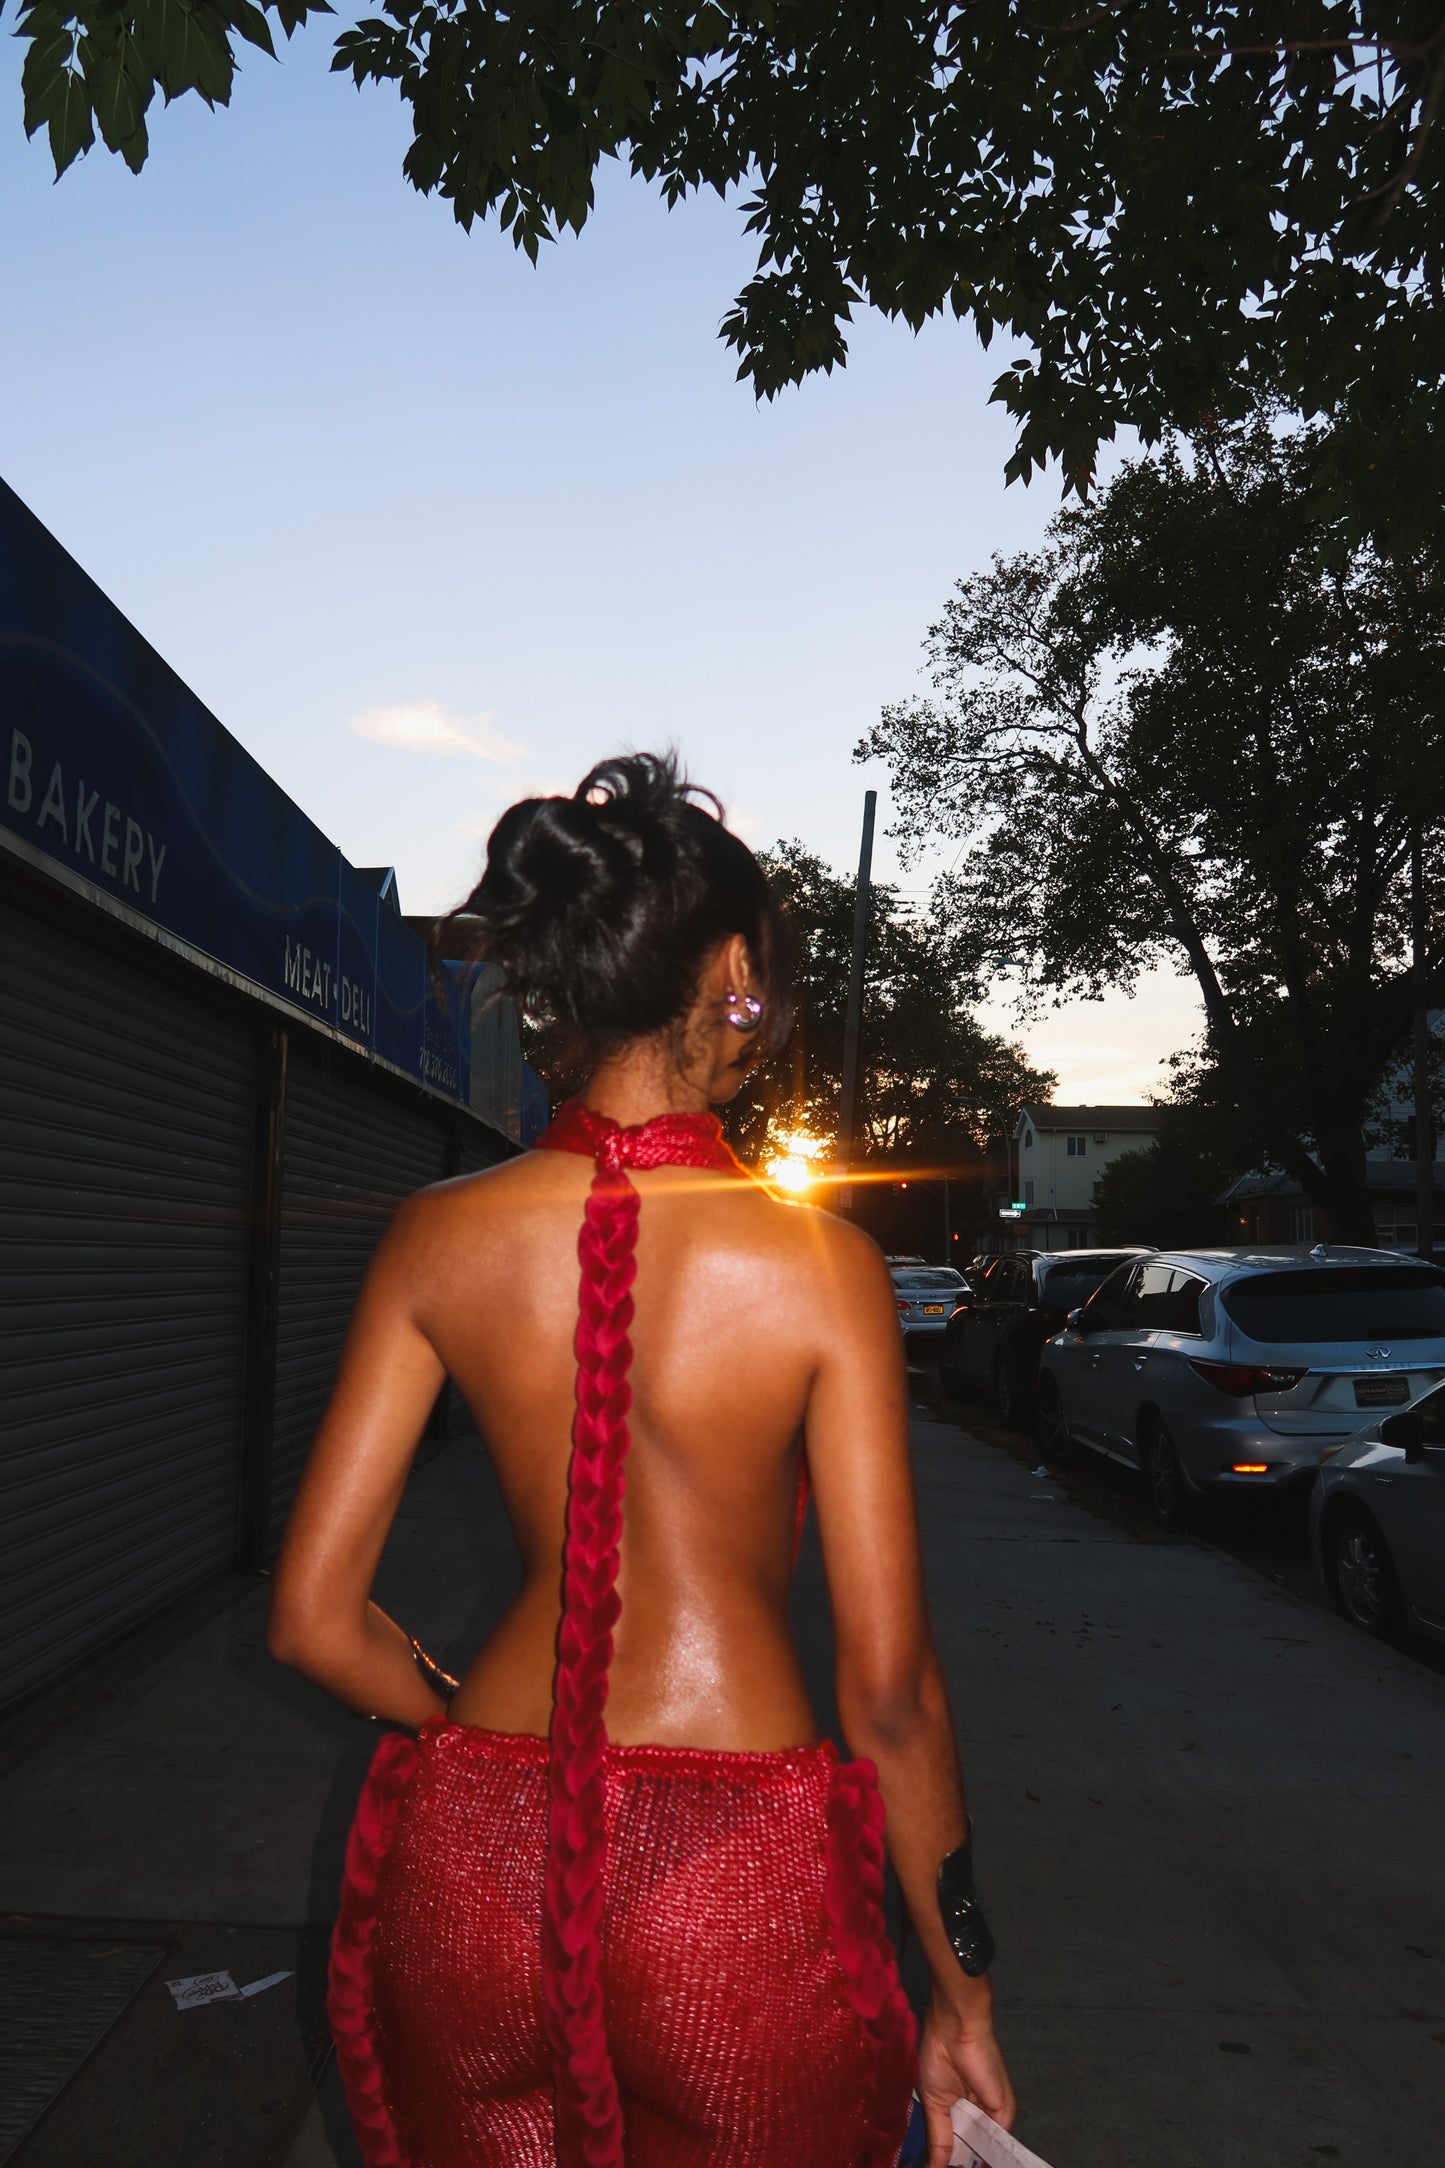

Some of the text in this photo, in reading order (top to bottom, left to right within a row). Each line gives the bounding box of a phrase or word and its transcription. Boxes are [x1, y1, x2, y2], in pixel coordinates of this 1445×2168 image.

[8, 727, 166, 904] BAKERY
[284, 934, 370, 1035] MEAT DELI
